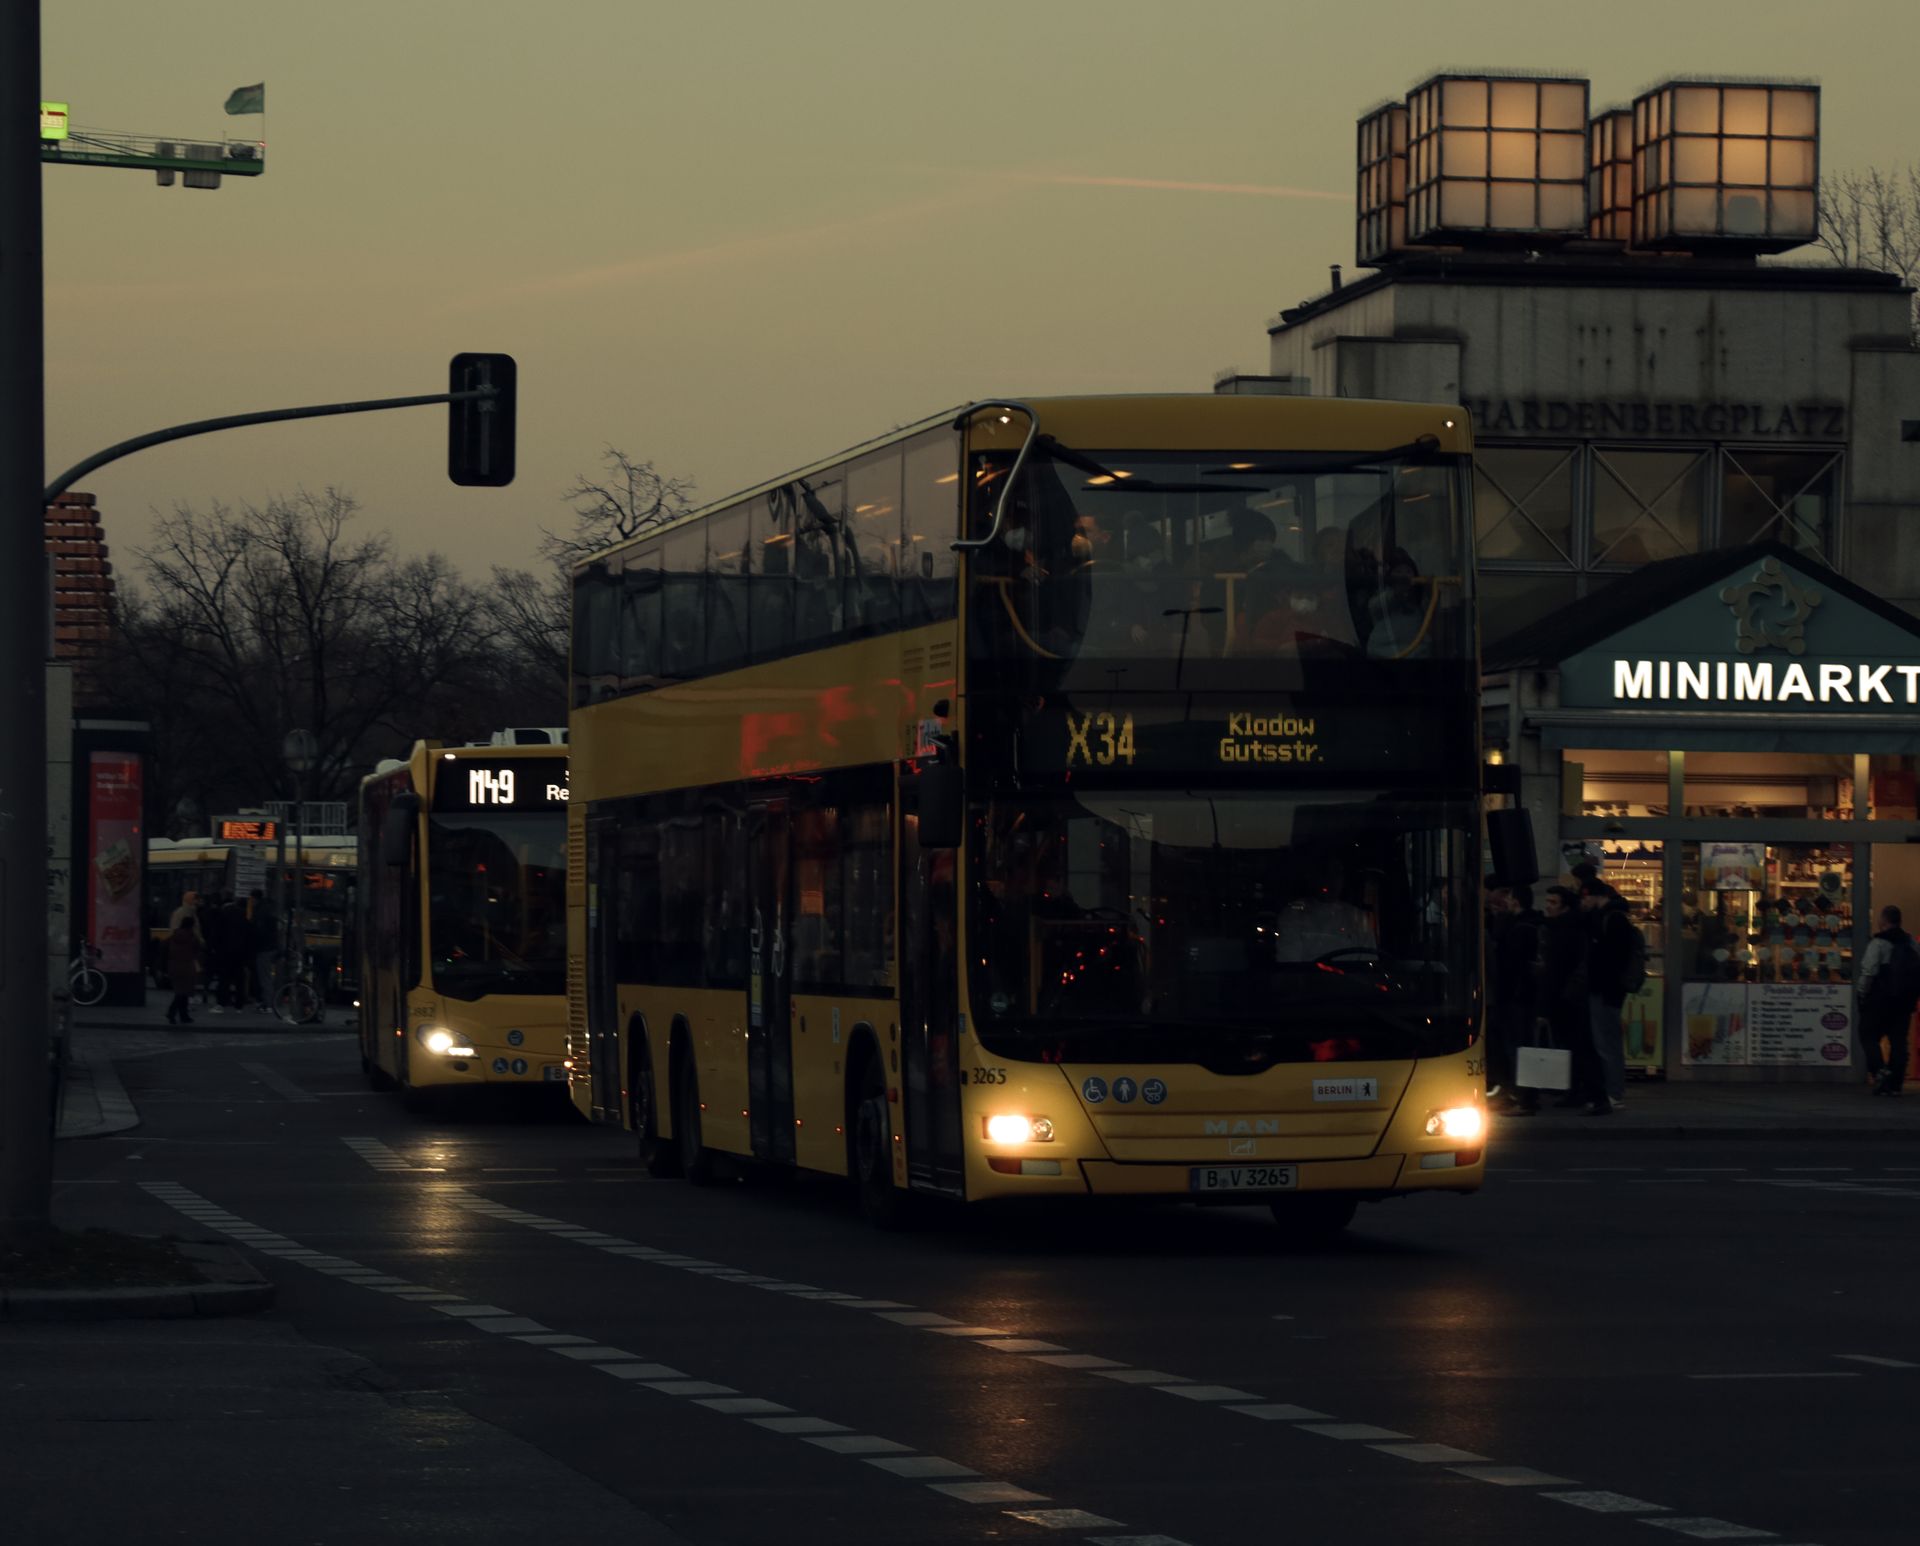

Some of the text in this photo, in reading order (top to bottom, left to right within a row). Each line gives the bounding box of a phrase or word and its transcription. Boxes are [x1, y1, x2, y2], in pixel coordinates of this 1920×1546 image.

[1472, 399, 1844, 435] HARDENBERGPLATZ
[1614, 659, 1920, 703] MINIMARKT
[1229, 712, 1315, 736] Kladow
[1066, 711, 1136, 764] X34
[1220, 738, 1324, 763] Gutsstr.
[469, 769, 515, 804] N49
[973, 1067, 1006, 1085] 3265
[1318, 1084, 1352, 1095] BERLIN
[1204, 1119, 1280, 1136] MAN
[1207, 1168, 1289, 1188] B V 3265
